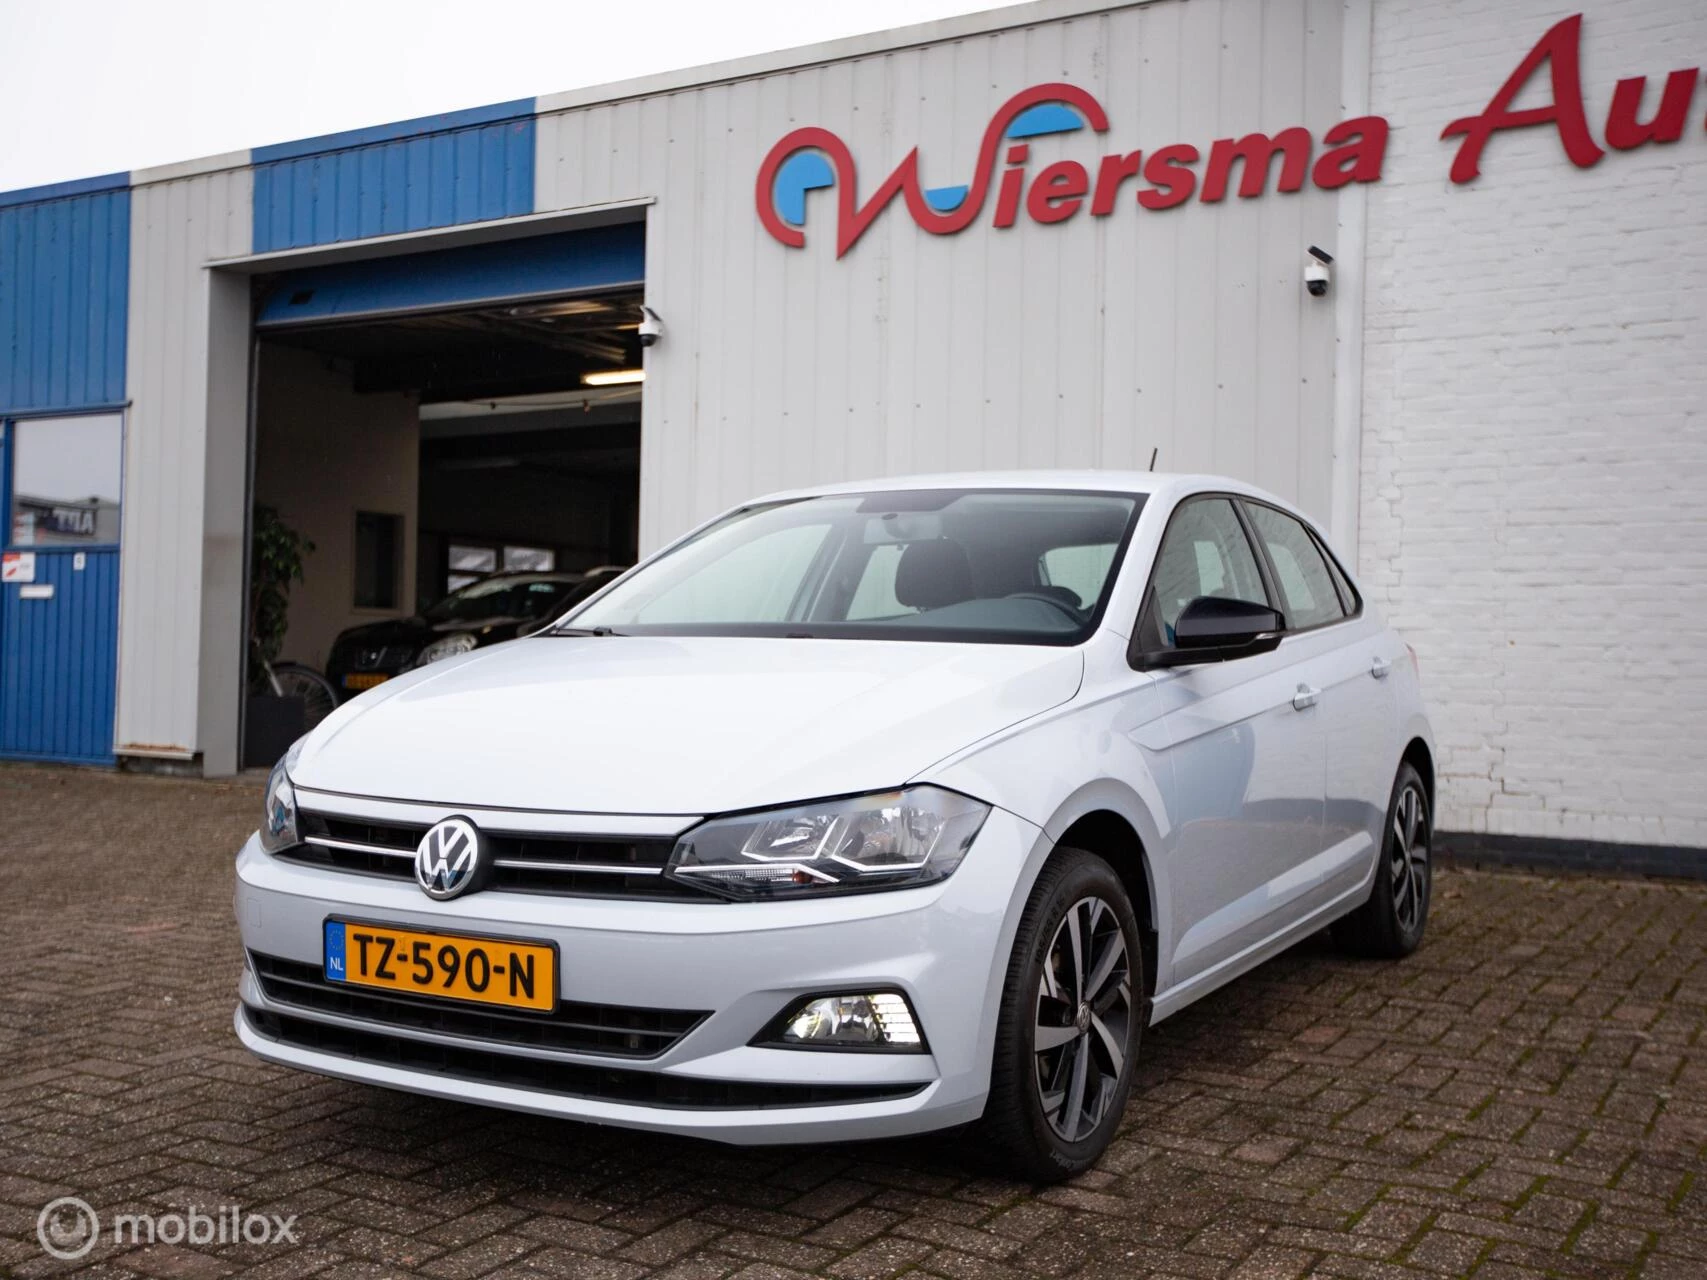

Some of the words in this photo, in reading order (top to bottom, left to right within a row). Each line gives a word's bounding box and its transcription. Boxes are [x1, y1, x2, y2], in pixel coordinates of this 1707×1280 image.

[756, 83, 1389, 260] Wiersma
[1439, 13, 1707, 184] Au
[330, 956, 344, 971] NL
[353, 933, 535, 999] TZ-590-N
